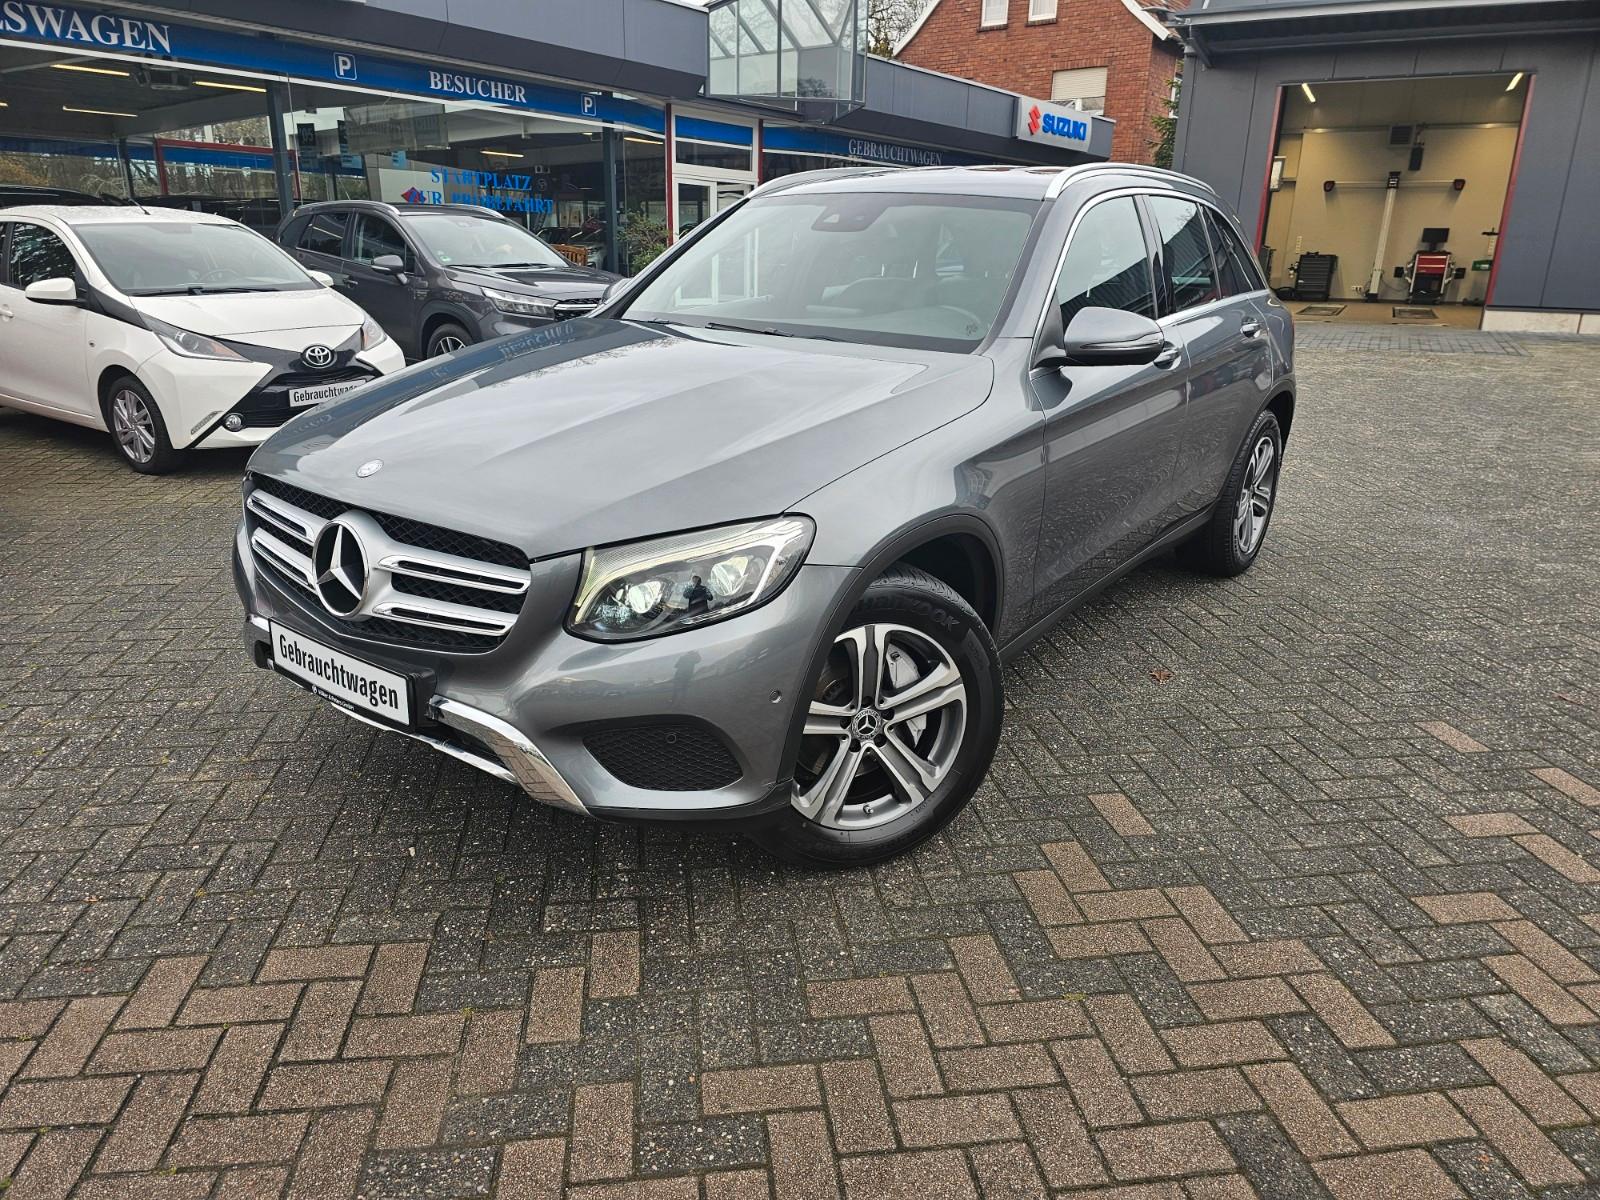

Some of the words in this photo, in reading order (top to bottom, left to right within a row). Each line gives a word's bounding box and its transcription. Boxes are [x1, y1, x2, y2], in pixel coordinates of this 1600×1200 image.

[0, 1, 172, 53] SWAGEN
[429, 70, 527, 103] BESUCHER
[1041, 113, 1088, 141] SUZUKI
[848, 139, 943, 166] GEBRAUCHTWAGEN
[293, 385, 358, 403] Gebrauchtwa
[279, 634, 399, 709] Gebrauchtwagen
